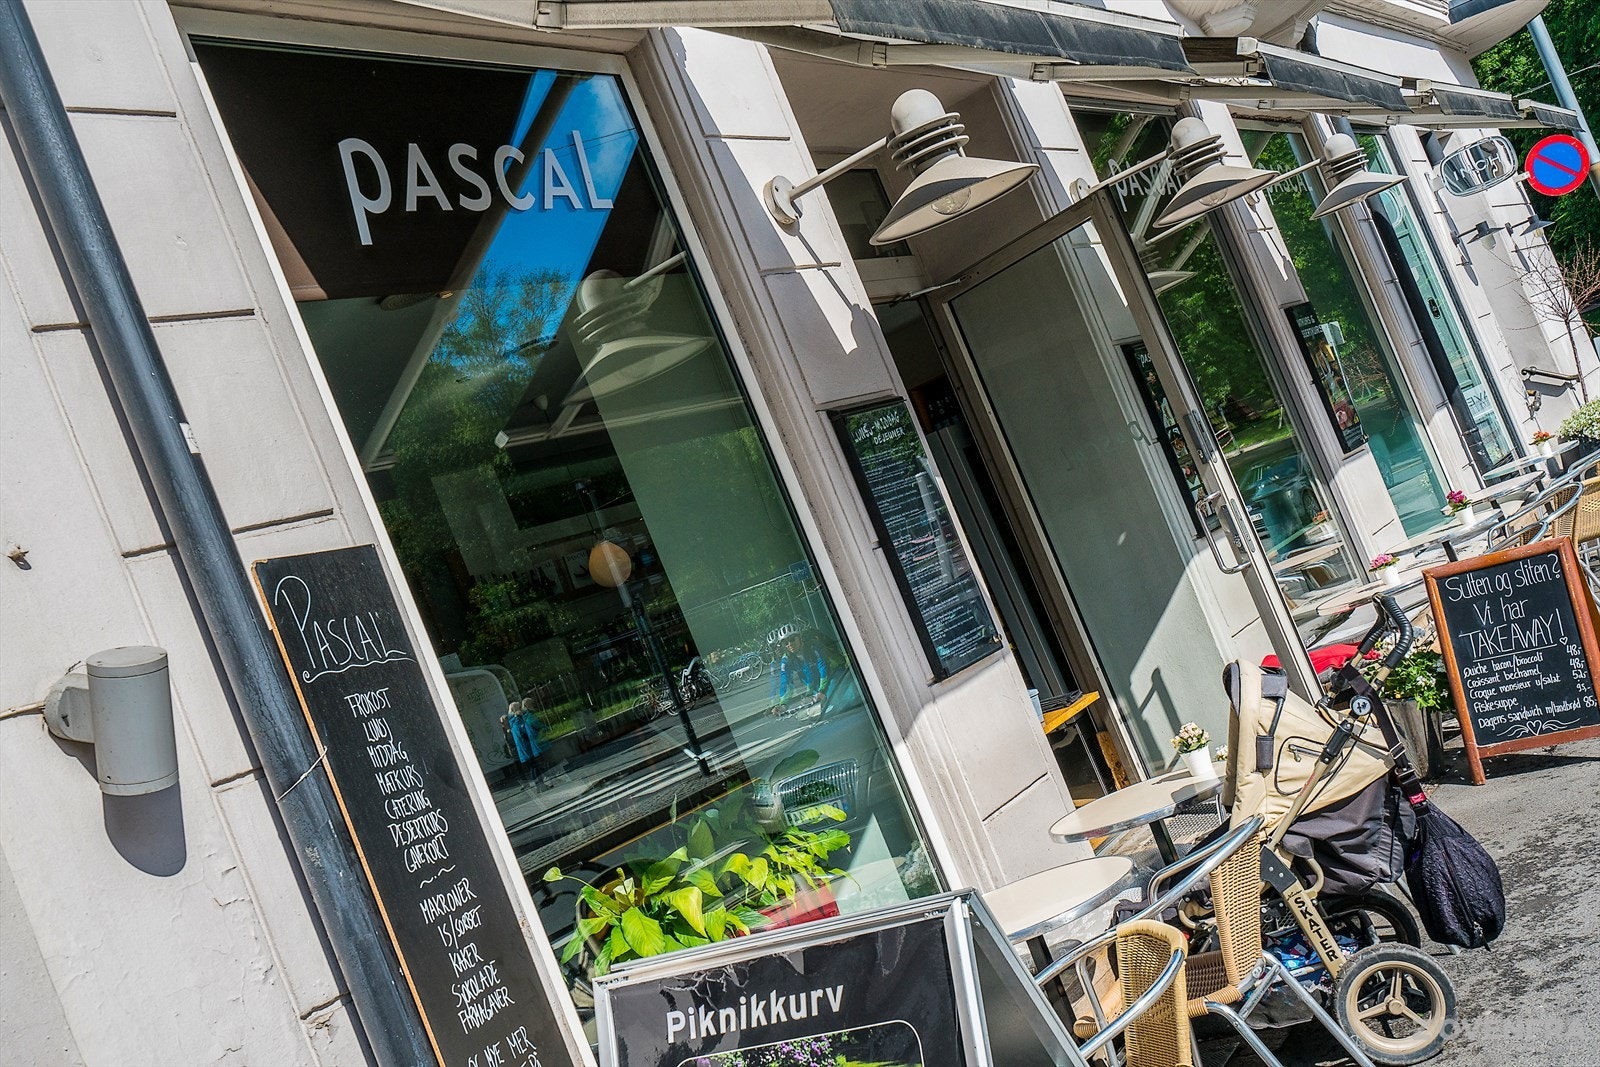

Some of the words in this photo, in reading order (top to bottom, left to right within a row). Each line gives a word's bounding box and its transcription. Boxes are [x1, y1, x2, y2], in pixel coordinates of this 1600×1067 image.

[338, 130, 614, 246] PASCAL
[1445, 573, 1493, 602] Sulten
[1495, 571, 1513, 598] og
[1515, 554, 1561, 588] sliten?
[274, 575, 406, 669] PASCAL
[1473, 600, 1494, 626] Vi
[1500, 597, 1528, 622] har
[1463, 662, 1489, 679] Quiche
[1466, 674, 1501, 689] Croissant
[1503, 664, 1542, 681] bechamel
[344, 687, 391, 718] FROKOST
[1469, 686, 1498, 701] Croque
[1499, 680, 1531, 693] monsieur
[1473, 696, 1519, 713] Fiskesuppe
[362, 717, 393, 743] LUNSJ
[1478, 713, 1507, 731] Dagens
[1507, 704, 1544, 722] sandwich
[366, 741, 409, 768] MIDDAG
[375, 764, 423, 795] MATKURS
[385, 789, 432, 820] CATERING
[387, 808, 449, 848] DESSERTKURS
[404, 833, 449, 873] GAVEKORT
[419, 877, 477, 925] MAKRONER
[1293, 896, 1339, 963] SKATER
[448, 942, 484, 978] KAKER
[457, 986, 515, 1035] FIRMAGAVER
[666, 984, 844, 1044] Piknikkurv
[506, 1026, 536, 1059] MER
